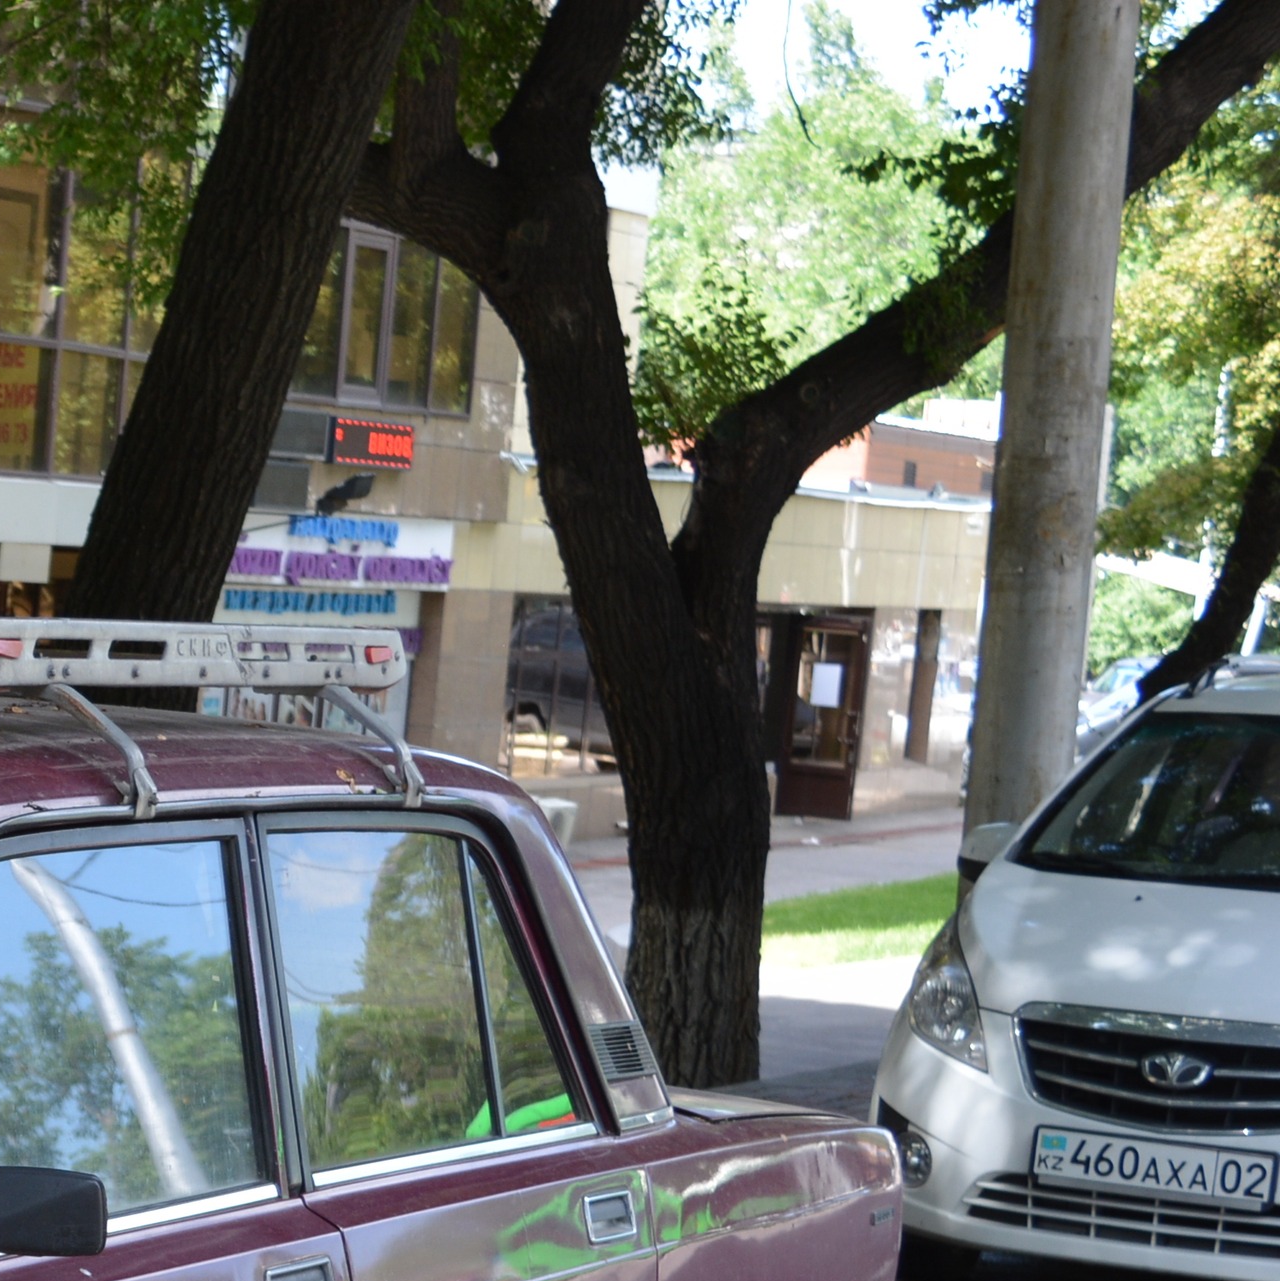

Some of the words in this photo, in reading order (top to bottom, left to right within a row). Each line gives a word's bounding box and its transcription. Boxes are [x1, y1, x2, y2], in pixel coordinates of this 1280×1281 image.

[1037, 1154, 1064, 1172] KZ
[1070, 1139, 1208, 1192] 460AXA
[1220, 1159, 1267, 1199] 02
